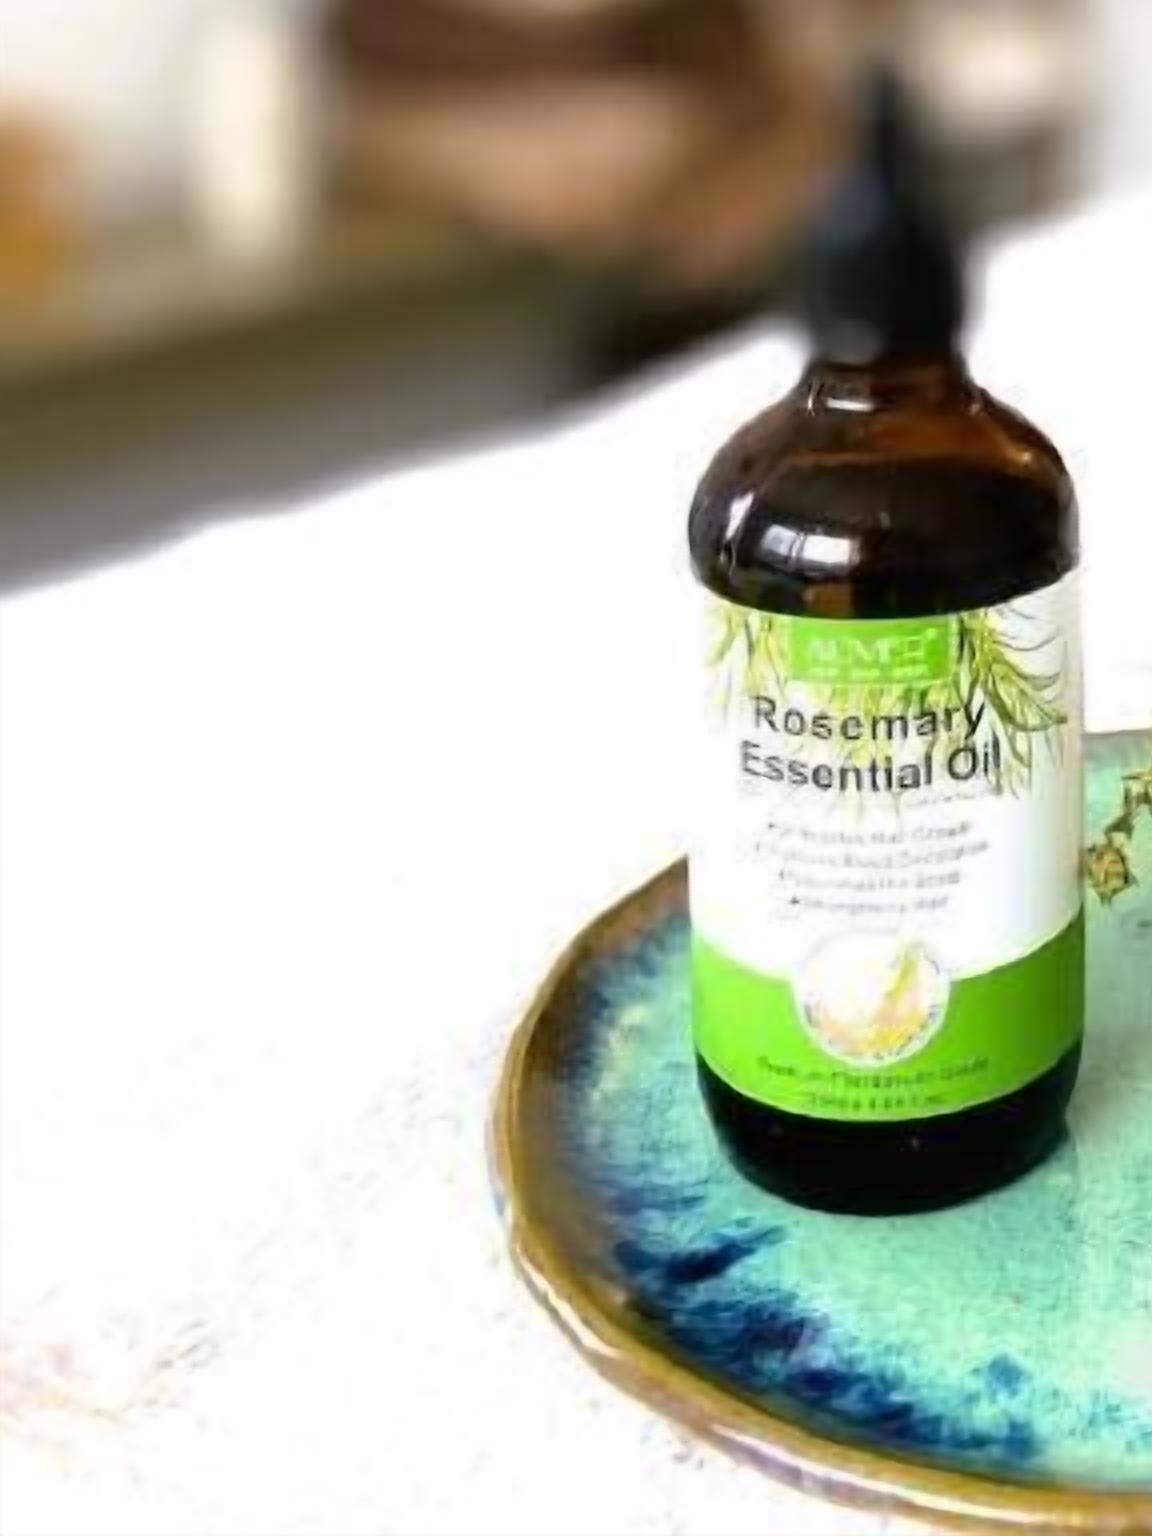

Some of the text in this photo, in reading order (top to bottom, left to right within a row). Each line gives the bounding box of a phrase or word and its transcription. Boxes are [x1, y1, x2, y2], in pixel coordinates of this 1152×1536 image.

[752, 695, 986, 741] Rosemary
[740, 736, 1002, 792] Essential Oil
